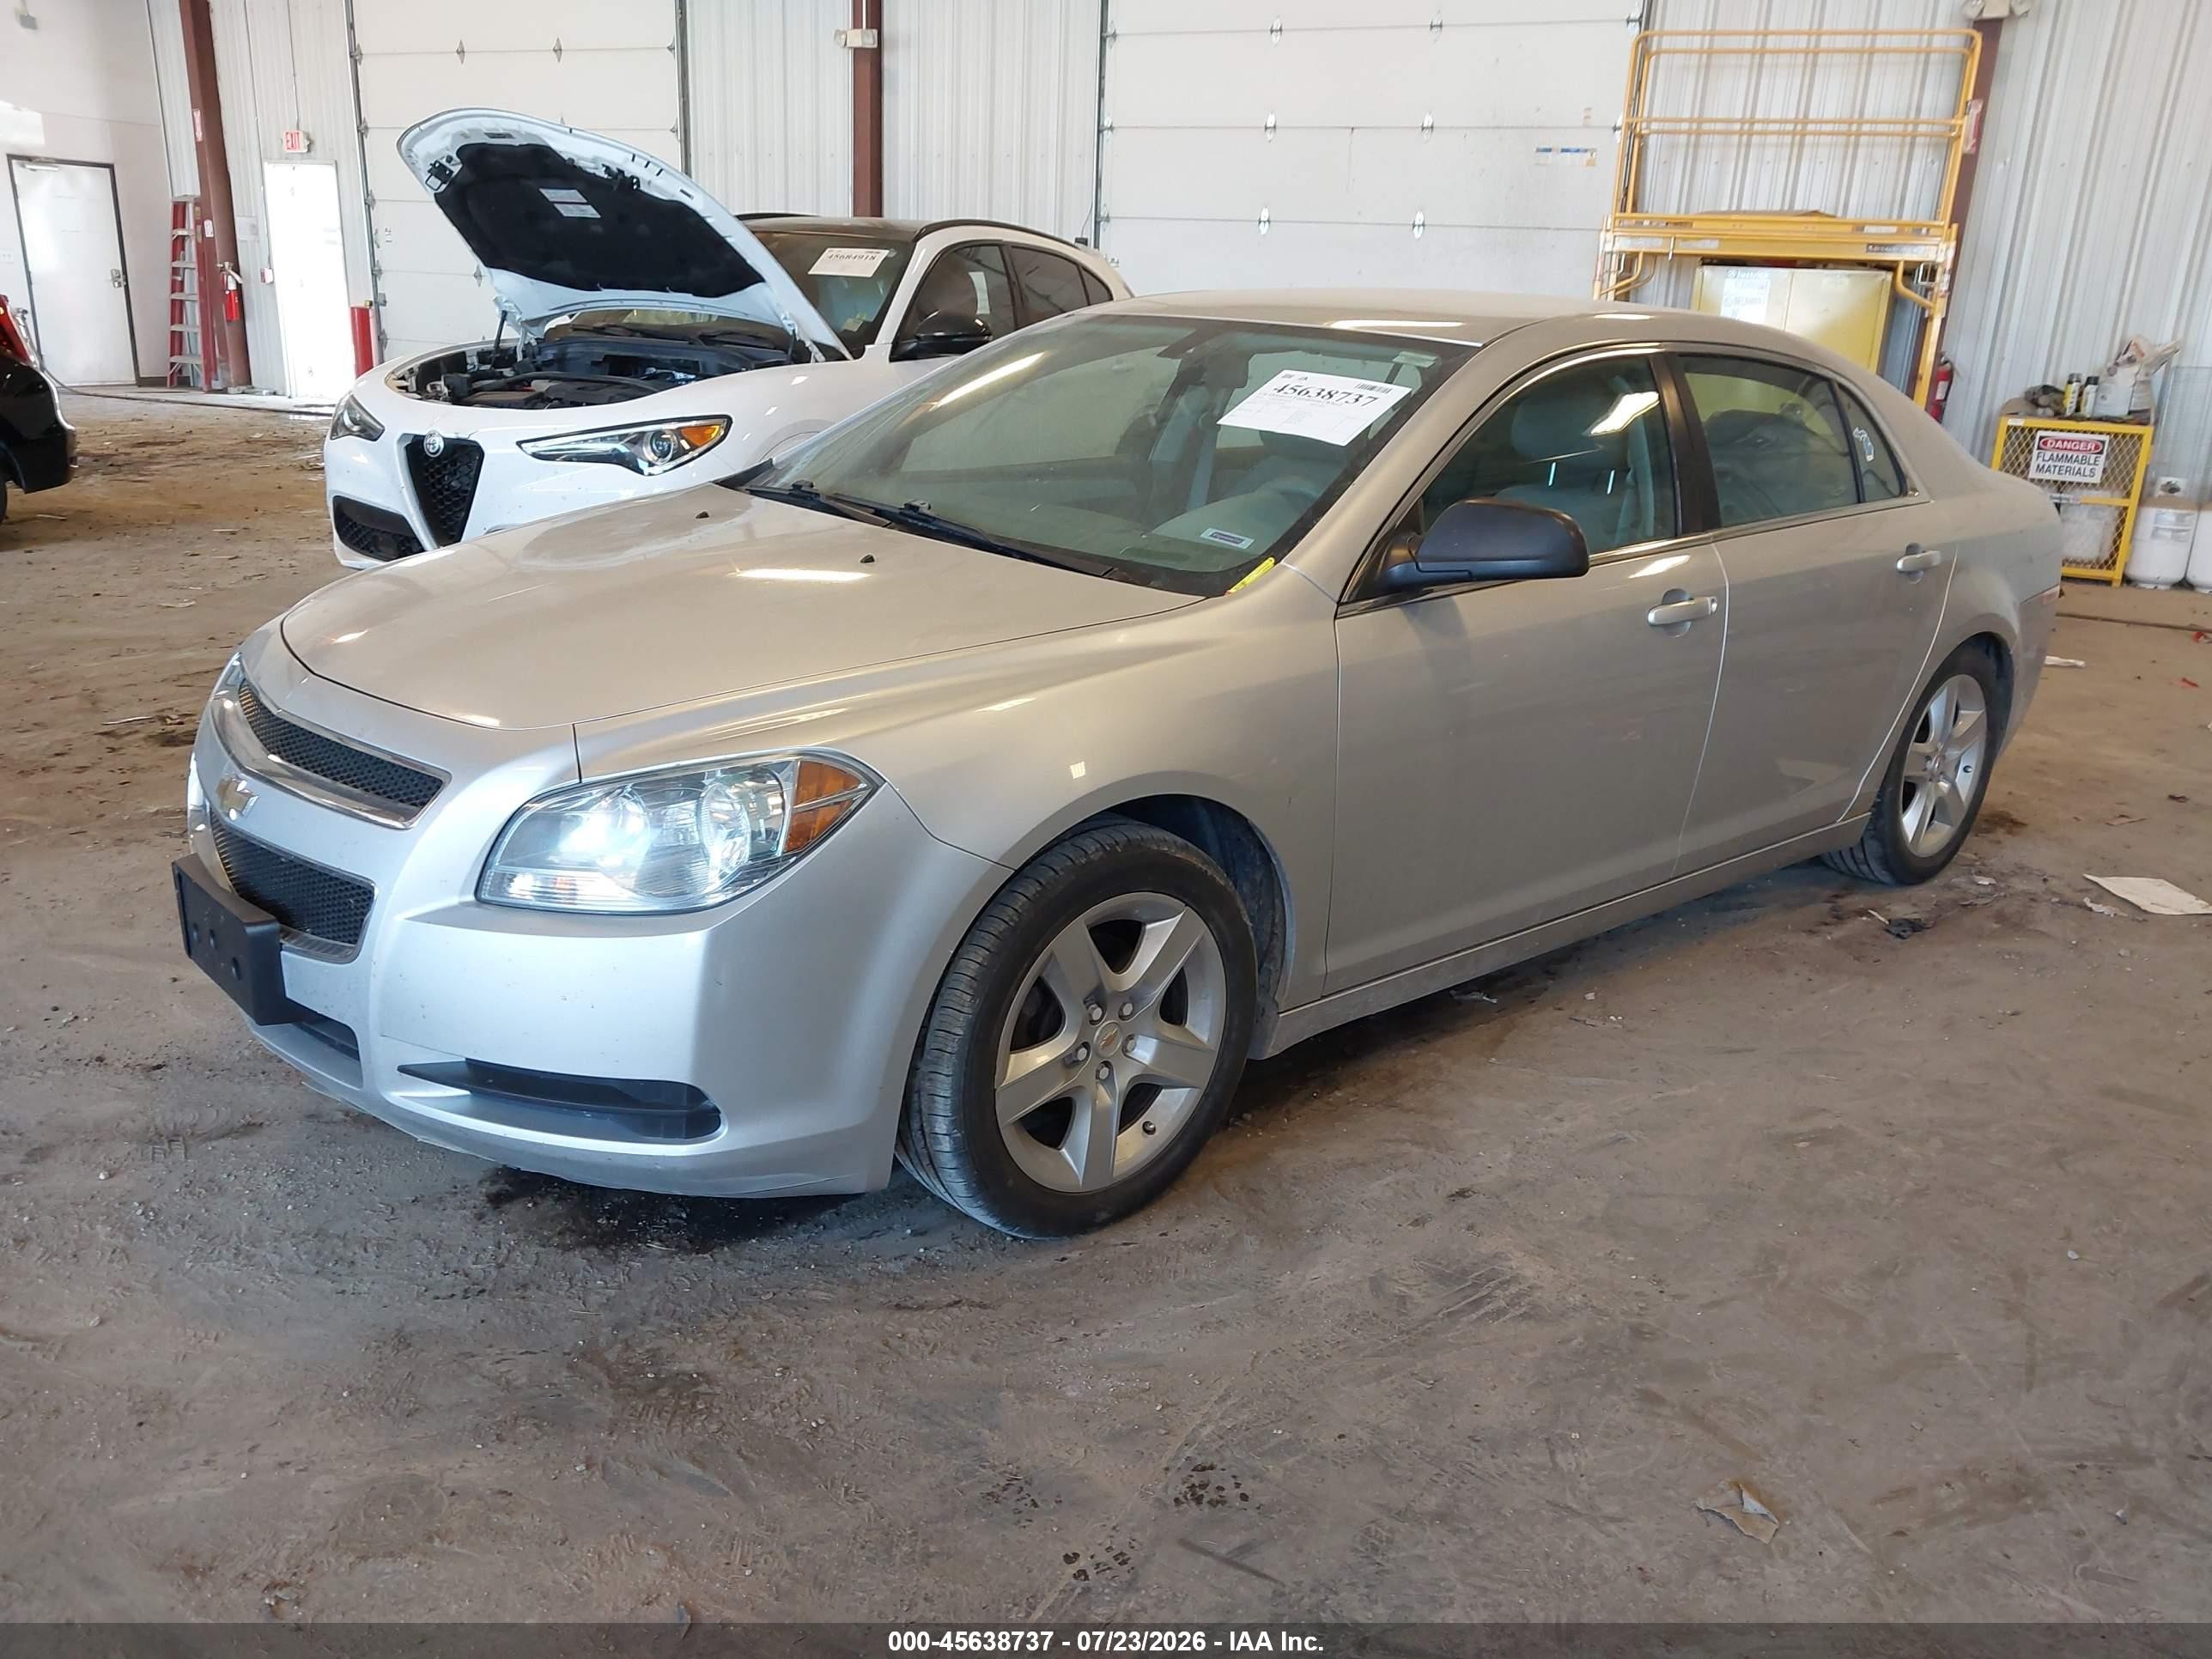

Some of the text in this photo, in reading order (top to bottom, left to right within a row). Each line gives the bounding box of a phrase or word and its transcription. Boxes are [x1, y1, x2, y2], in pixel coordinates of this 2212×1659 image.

[285, 131, 301, 150] EXIT
[1273, 383, 1380, 407] 45638737
[2046, 439, 2096, 452] DANGER
[2035, 452, 2101, 466] FLAMMABLE
[2035, 464, 2097, 478] MATERIALS
